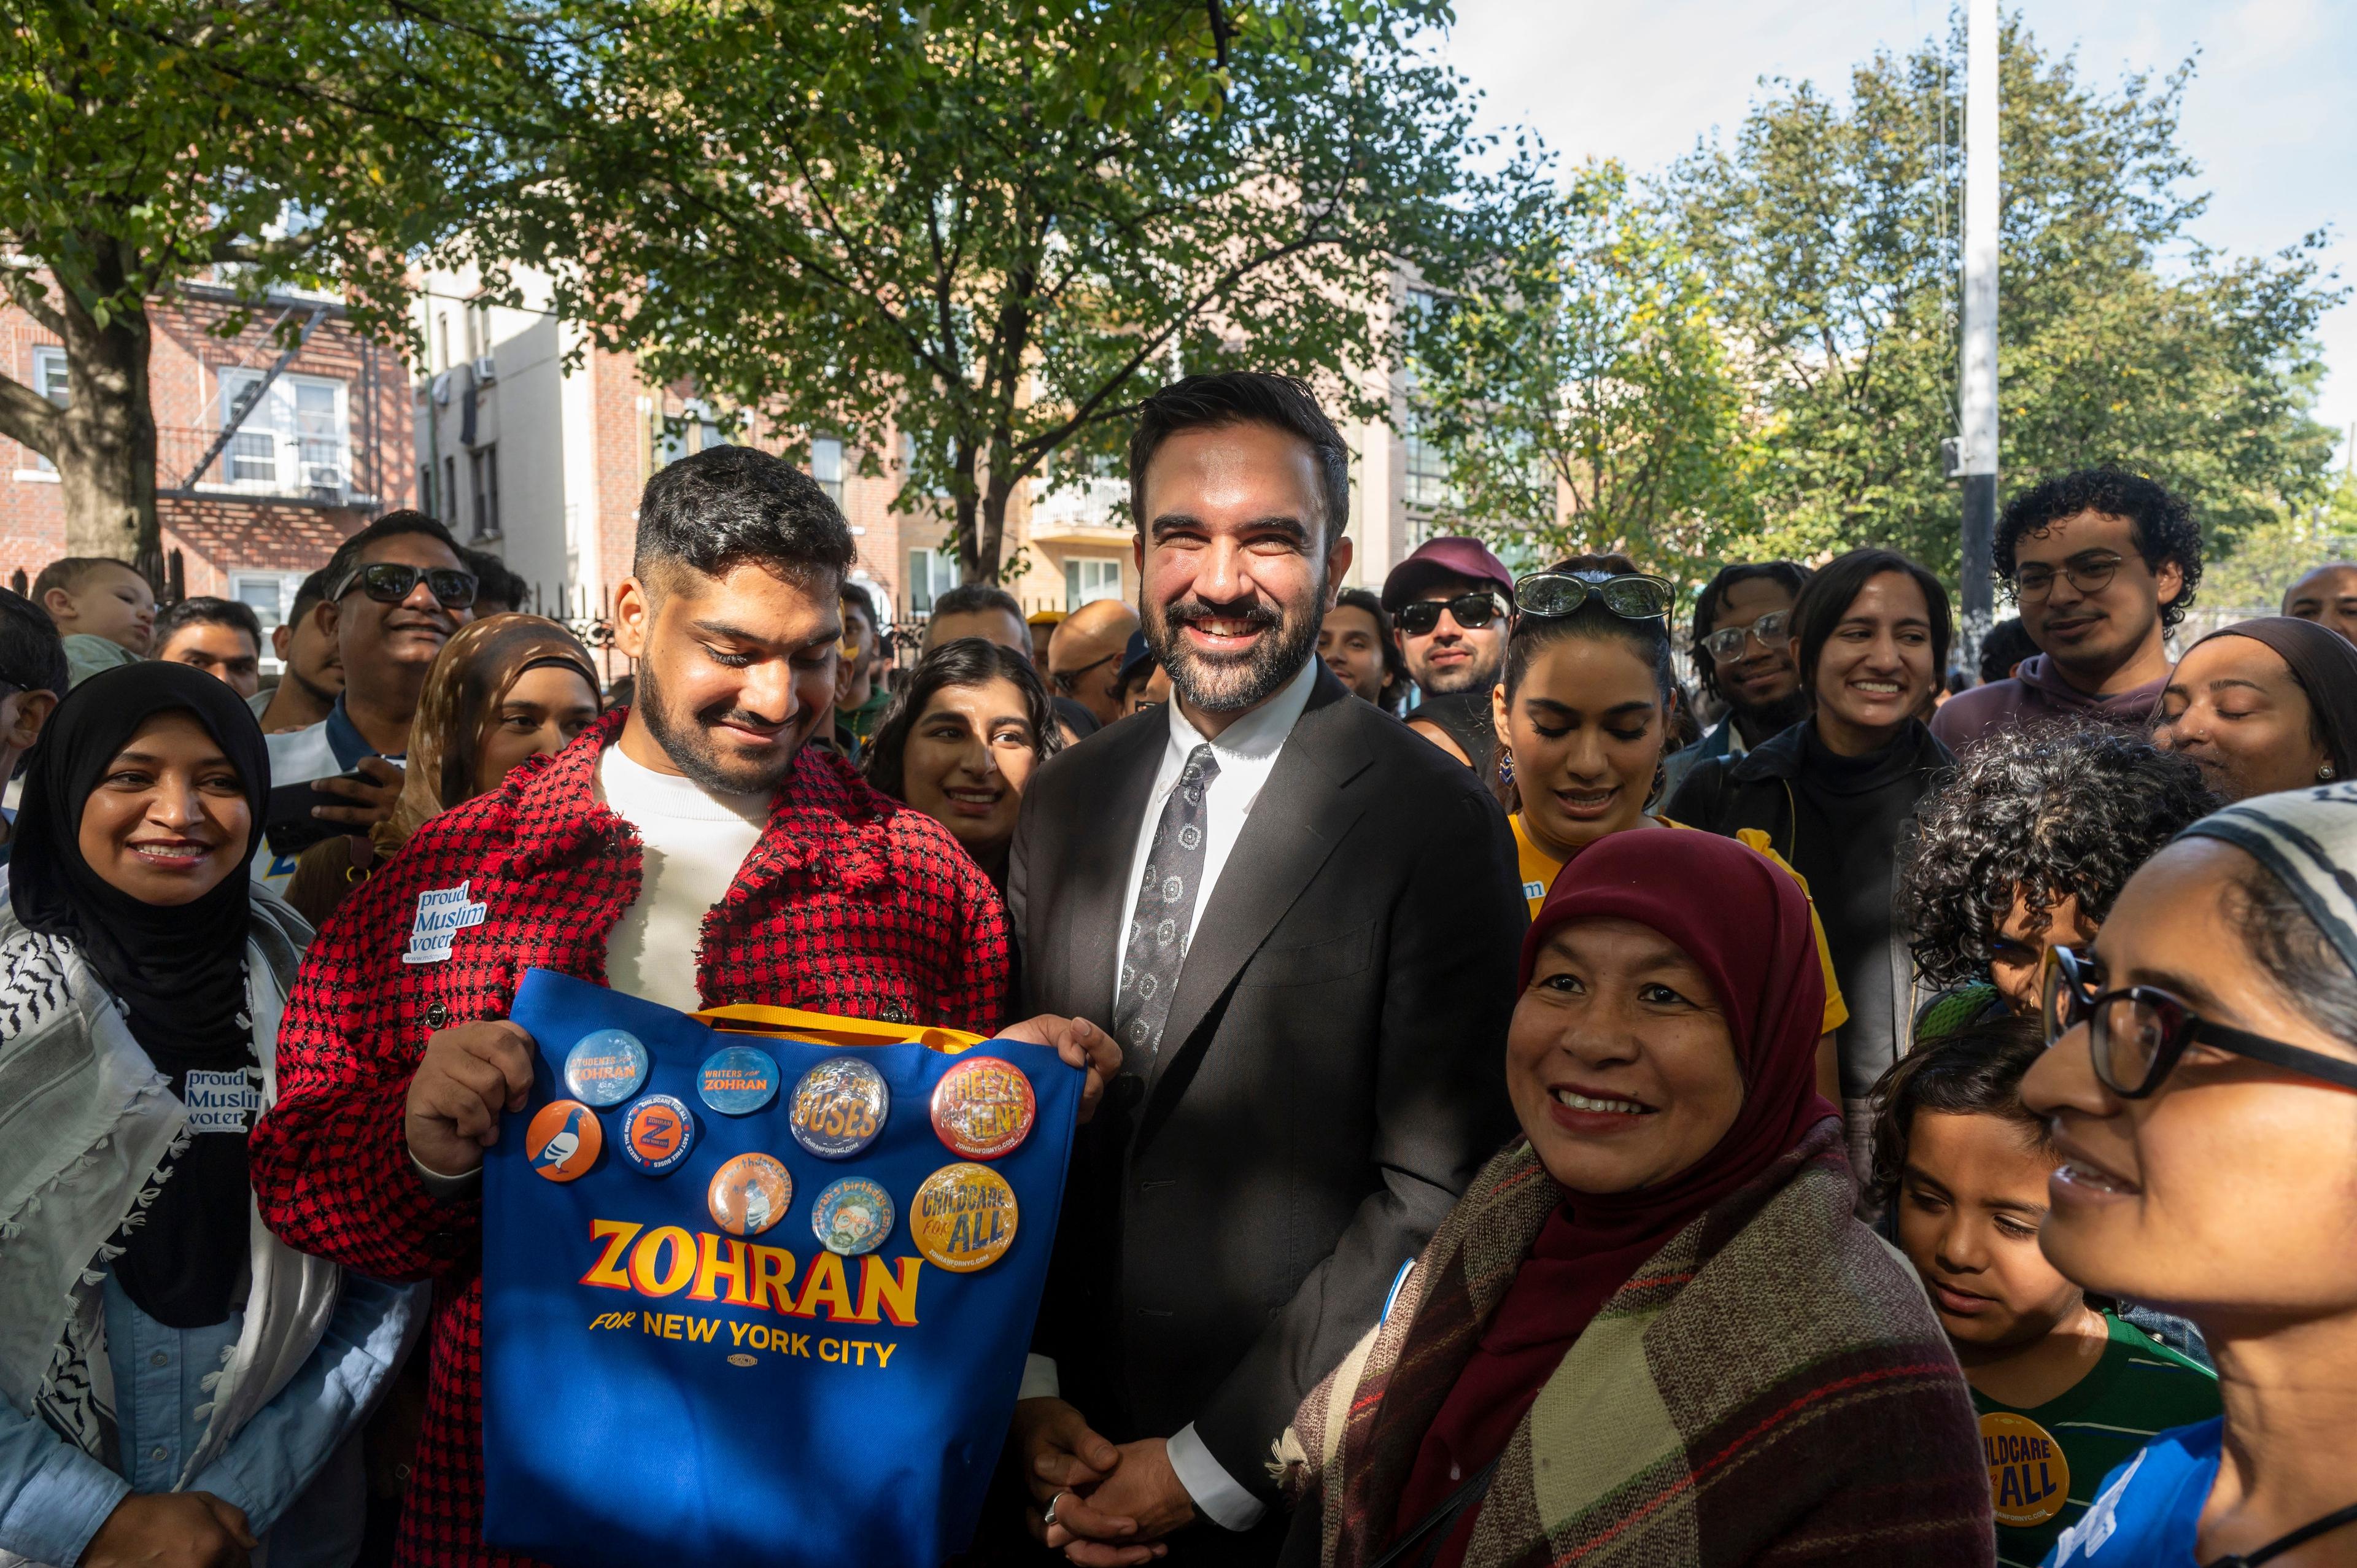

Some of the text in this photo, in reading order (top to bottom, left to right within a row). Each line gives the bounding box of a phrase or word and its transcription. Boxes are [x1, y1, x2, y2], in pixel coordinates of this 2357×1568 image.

[420, 884, 467, 911] proud
[416, 904, 484, 932] Muslim
[412, 933, 454, 951] voter
[188, 1071, 244, 1087] proud
[703, 1079, 767, 1091] ZOHRAN
[943, 1070, 1024, 1103] FREEZE
[189, 1111, 244, 1124] voter
[641, 1098, 687, 1122] CHILDCARE FOR ALL
[793, 1092, 879, 1138] BUSES
[624, 1117, 633, 1133] RENT
[627, 1145, 642, 1163] FREEZE
[673, 1148, 684, 1161] FREE
[802, 1135, 859, 1154] ZOHRANFORNYC.COM
[955, 1137, 1016, 1154] ZOHRANFORNYC.COM
[653, 1159, 673, 1168] BUSES
[843, 1181, 887, 1207] birthday
[922, 1184, 1007, 1218] CHILDCARE
[923, 1210, 1005, 1254] FOR ALL
[929, 1248, 990, 1267] ZOHRANFORNYC.COM
[578, 1219, 925, 1327] ZOHRAN
[589, 1311, 897, 1368] FOR NEW YORK CITY
[1983, 1435, 2051, 1466] ILDCARE
[1999, 1462, 2057, 1507] ALL
[1993, 1508, 2048, 1522] RANFORNYC.COM
